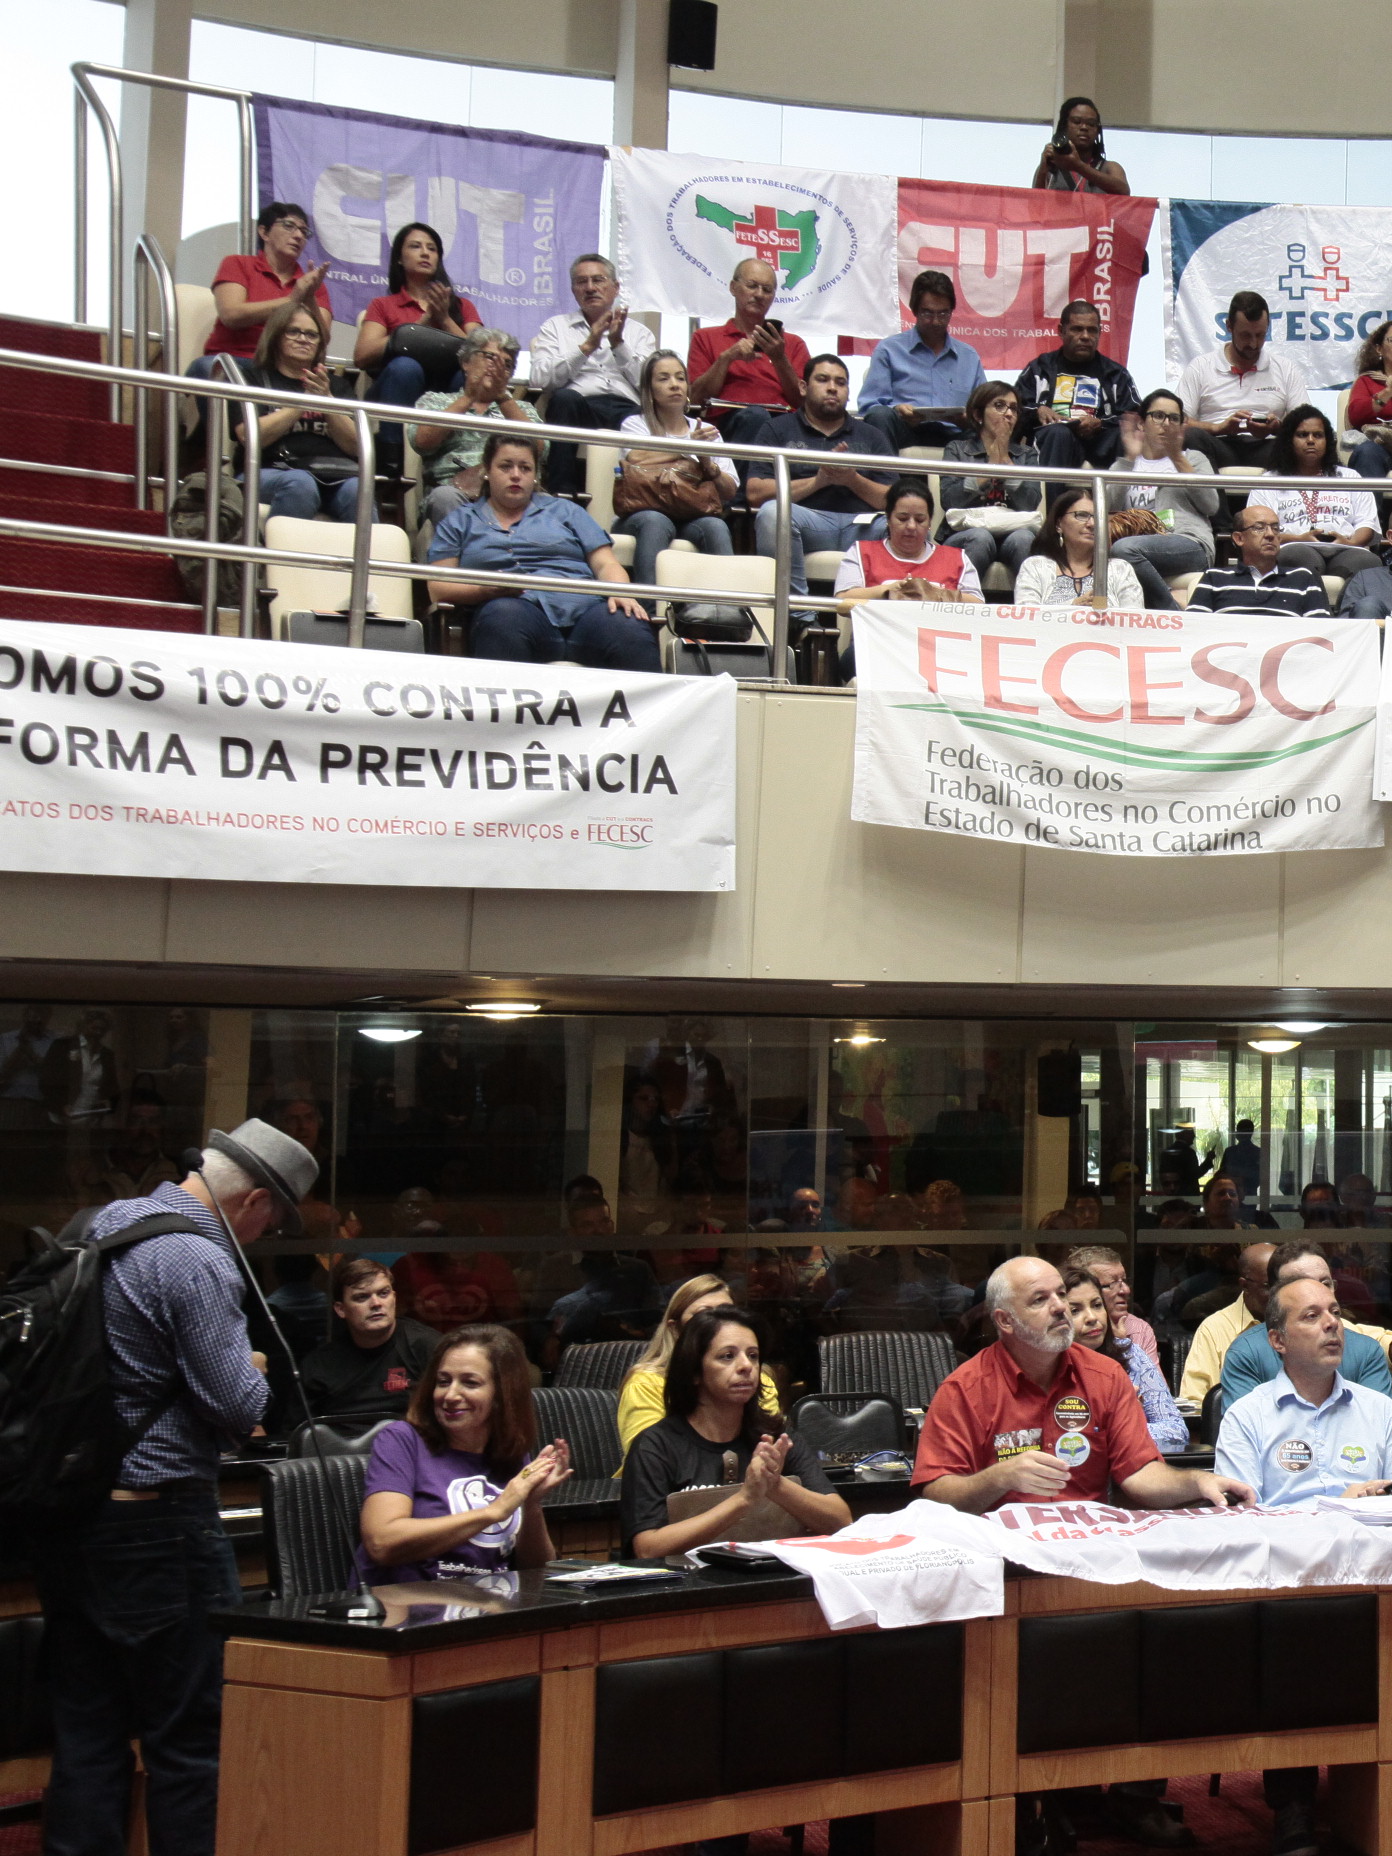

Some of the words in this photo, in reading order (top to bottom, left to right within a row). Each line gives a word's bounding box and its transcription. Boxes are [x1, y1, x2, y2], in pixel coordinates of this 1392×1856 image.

[669, 175, 729, 209] TRABALHADORES
[746, 177, 834, 207] ESTABELECIMENTOS
[313, 163, 525, 286] CUT
[666, 212, 674, 231] DOS
[833, 206, 845, 218] DE
[533, 188, 555, 294] BRASIL
[325, 270, 368, 285] NTRAL
[841, 263, 851, 275] DE
[899, 221, 1090, 318] CUT
[1093, 218, 1116, 321] BRASIL
[452, 284, 555, 308] RABALHADORES
[774, 295, 801, 304] ARINA
[983, 327, 1008, 338] DOS
[1129, 492, 1156, 508] VAL
[1318, 495, 1350, 504] IREITOS
[980, 606, 991, 618] a
[996, 605, 1041, 622] CUT
[1042, 610, 1052, 623] e
[1057, 612, 1068, 624] a
[1071, 609, 1184, 631] CONTRACS
[0, 646, 165, 702] OMOS
[187, 666, 341, 714] 100%
[362, 681, 583, 728] CONTRA
[599, 689, 637, 728] A
[916, 626, 1338, 727] FECESC
[0, 718, 198, 777] FORMA
[219, 736, 297, 783] DA
[318, 740, 680, 796] PREVIDÊNCIA
[926, 739, 1064, 789] Federação
[1073, 764, 1124, 792] dos
[925, 768, 1113, 824] Trabalhadores
[1123, 803, 1159, 825] no
[1168, 794, 1296, 825] Comércio
[1306, 793, 1342, 814] no
[0, 799, 61, 820] ATOS
[68, 803, 114, 822] DOS
[122, 804, 305, 832] TRABALHADORES
[312, 816, 340, 833] NO
[347, 815, 448, 837] COMÉRCIO
[454, 821, 467, 837] E
[472, 821, 564, 843] SERVIÇOS
[570, 828, 581, 841] e
[587, 823, 654, 843] FECESC
[923, 800, 1014, 838] Estado
[1024, 816, 1060, 848] de
[1069, 825, 1144, 852] Santa
[1152, 828, 1263, 853] Catarina
[1285, 1441, 1305, 1450] NÃO
[868, 1566, 902, 1575] PRIVADO
